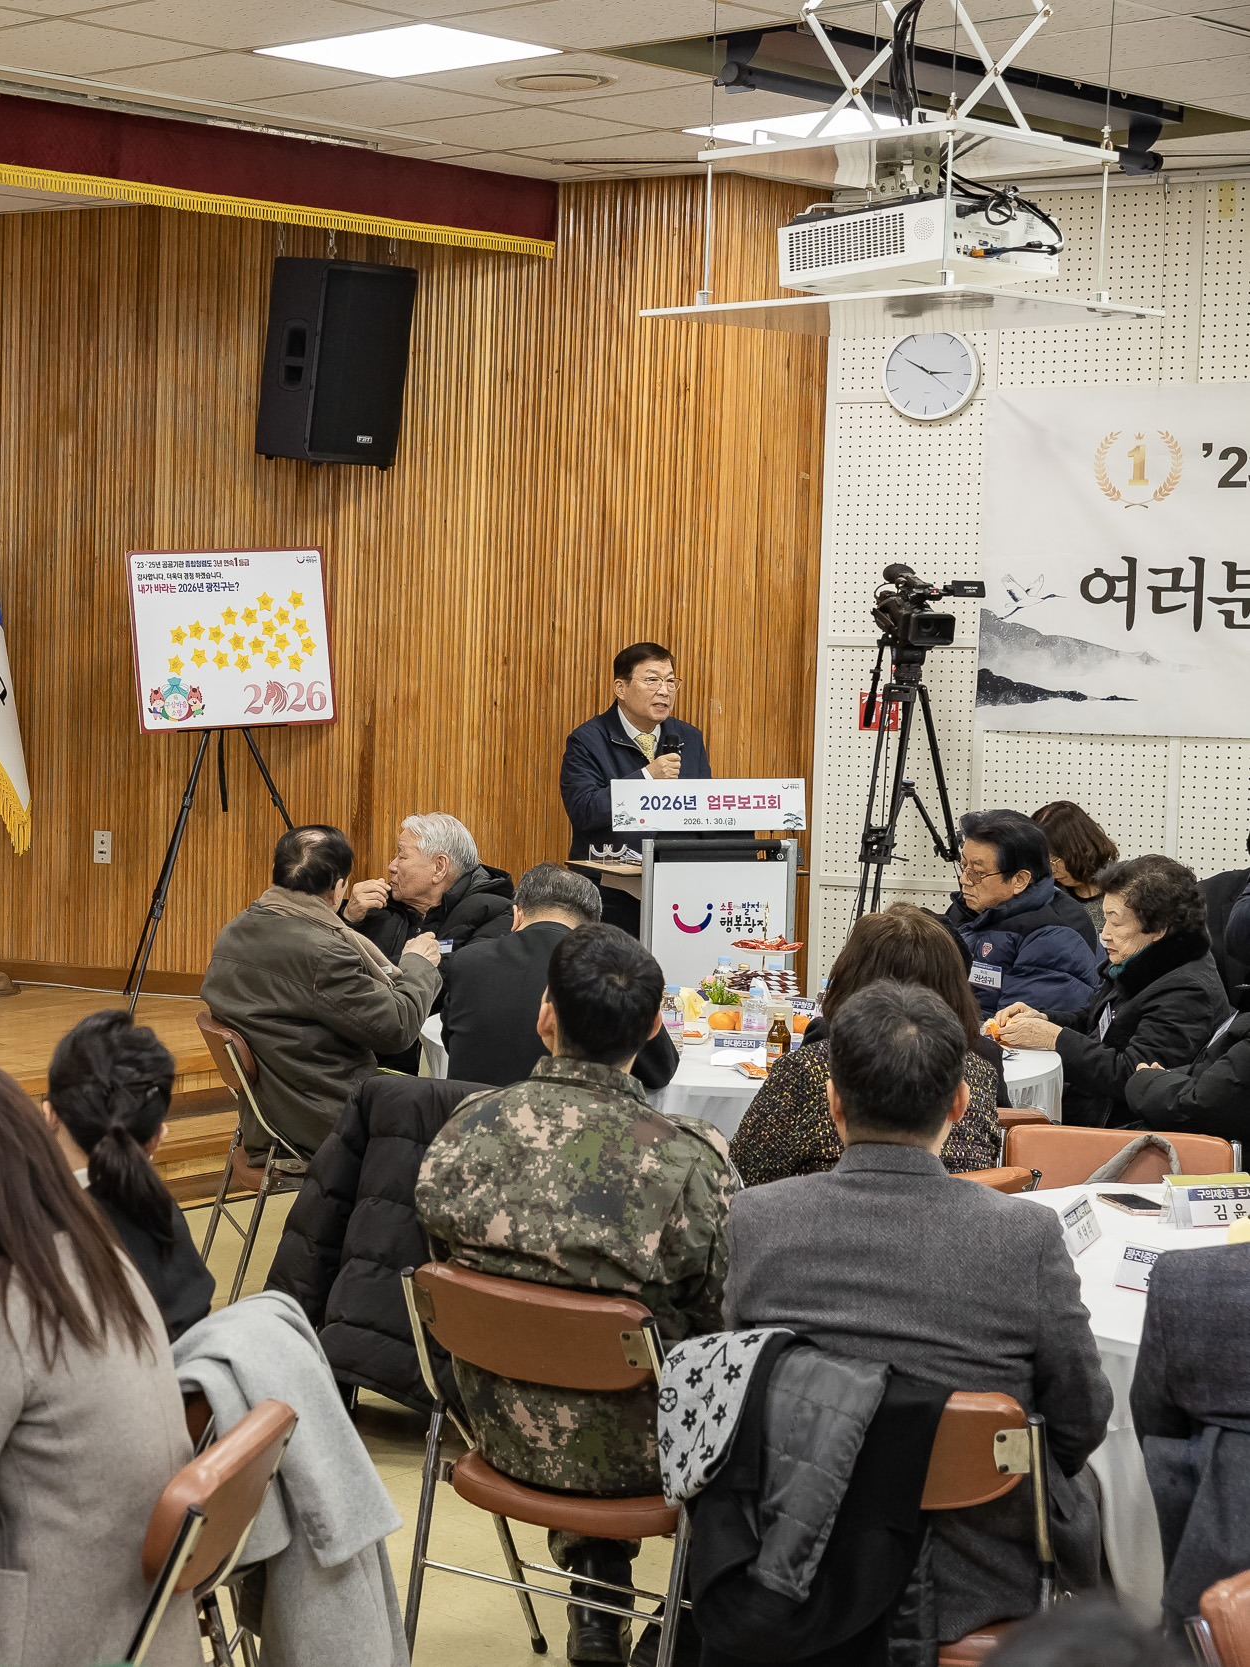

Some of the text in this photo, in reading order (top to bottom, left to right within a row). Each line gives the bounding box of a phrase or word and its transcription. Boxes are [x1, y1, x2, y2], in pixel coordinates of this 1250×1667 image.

[1202, 442, 1250, 488] '2
[161, 560, 184, 568] 공공기관
[213, 559, 222, 567] 3년
[136, 573, 166, 581] 감사합니다.
[166, 572, 183, 580] 더욱더
[137, 582, 240, 594] 내가 바라는 2026년 광진구는?
[639, 794, 781, 811] 2026년 업무보고회
[683, 817, 703, 826] 2026.
[1197, 1188, 1235, 1200] 구의제3동
